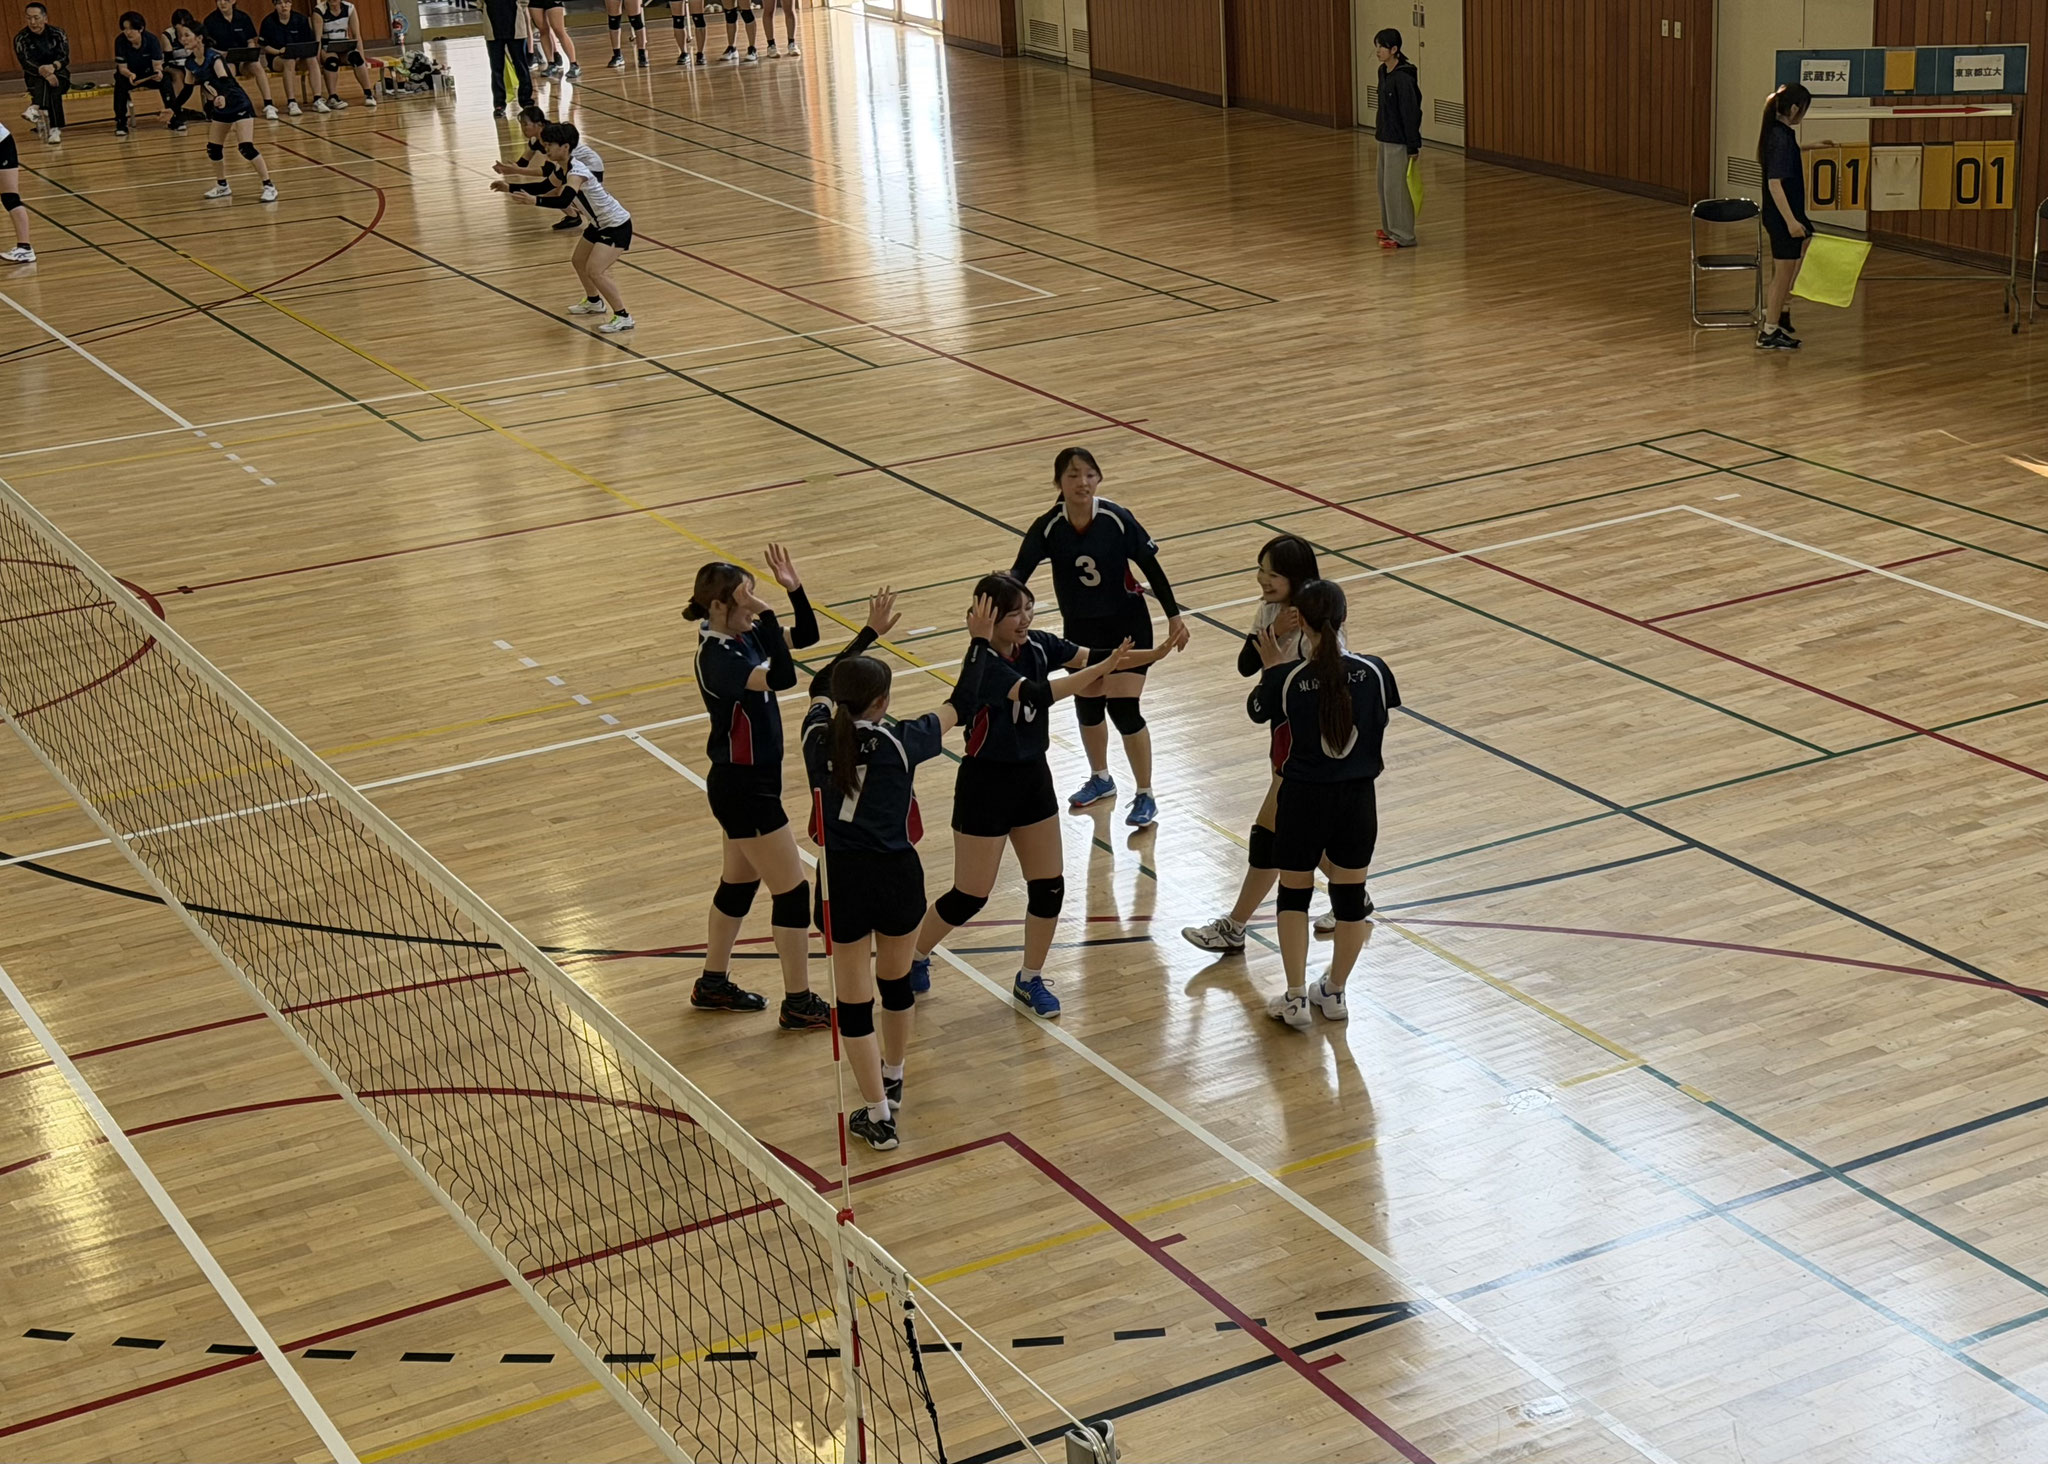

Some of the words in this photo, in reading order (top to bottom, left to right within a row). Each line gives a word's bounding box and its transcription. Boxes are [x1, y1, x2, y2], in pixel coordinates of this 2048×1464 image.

[1802, 71, 1847, 82] 武蔵野大
[1955, 67, 2002, 78] 東京都立大
[1075, 555, 1101, 587] 3
